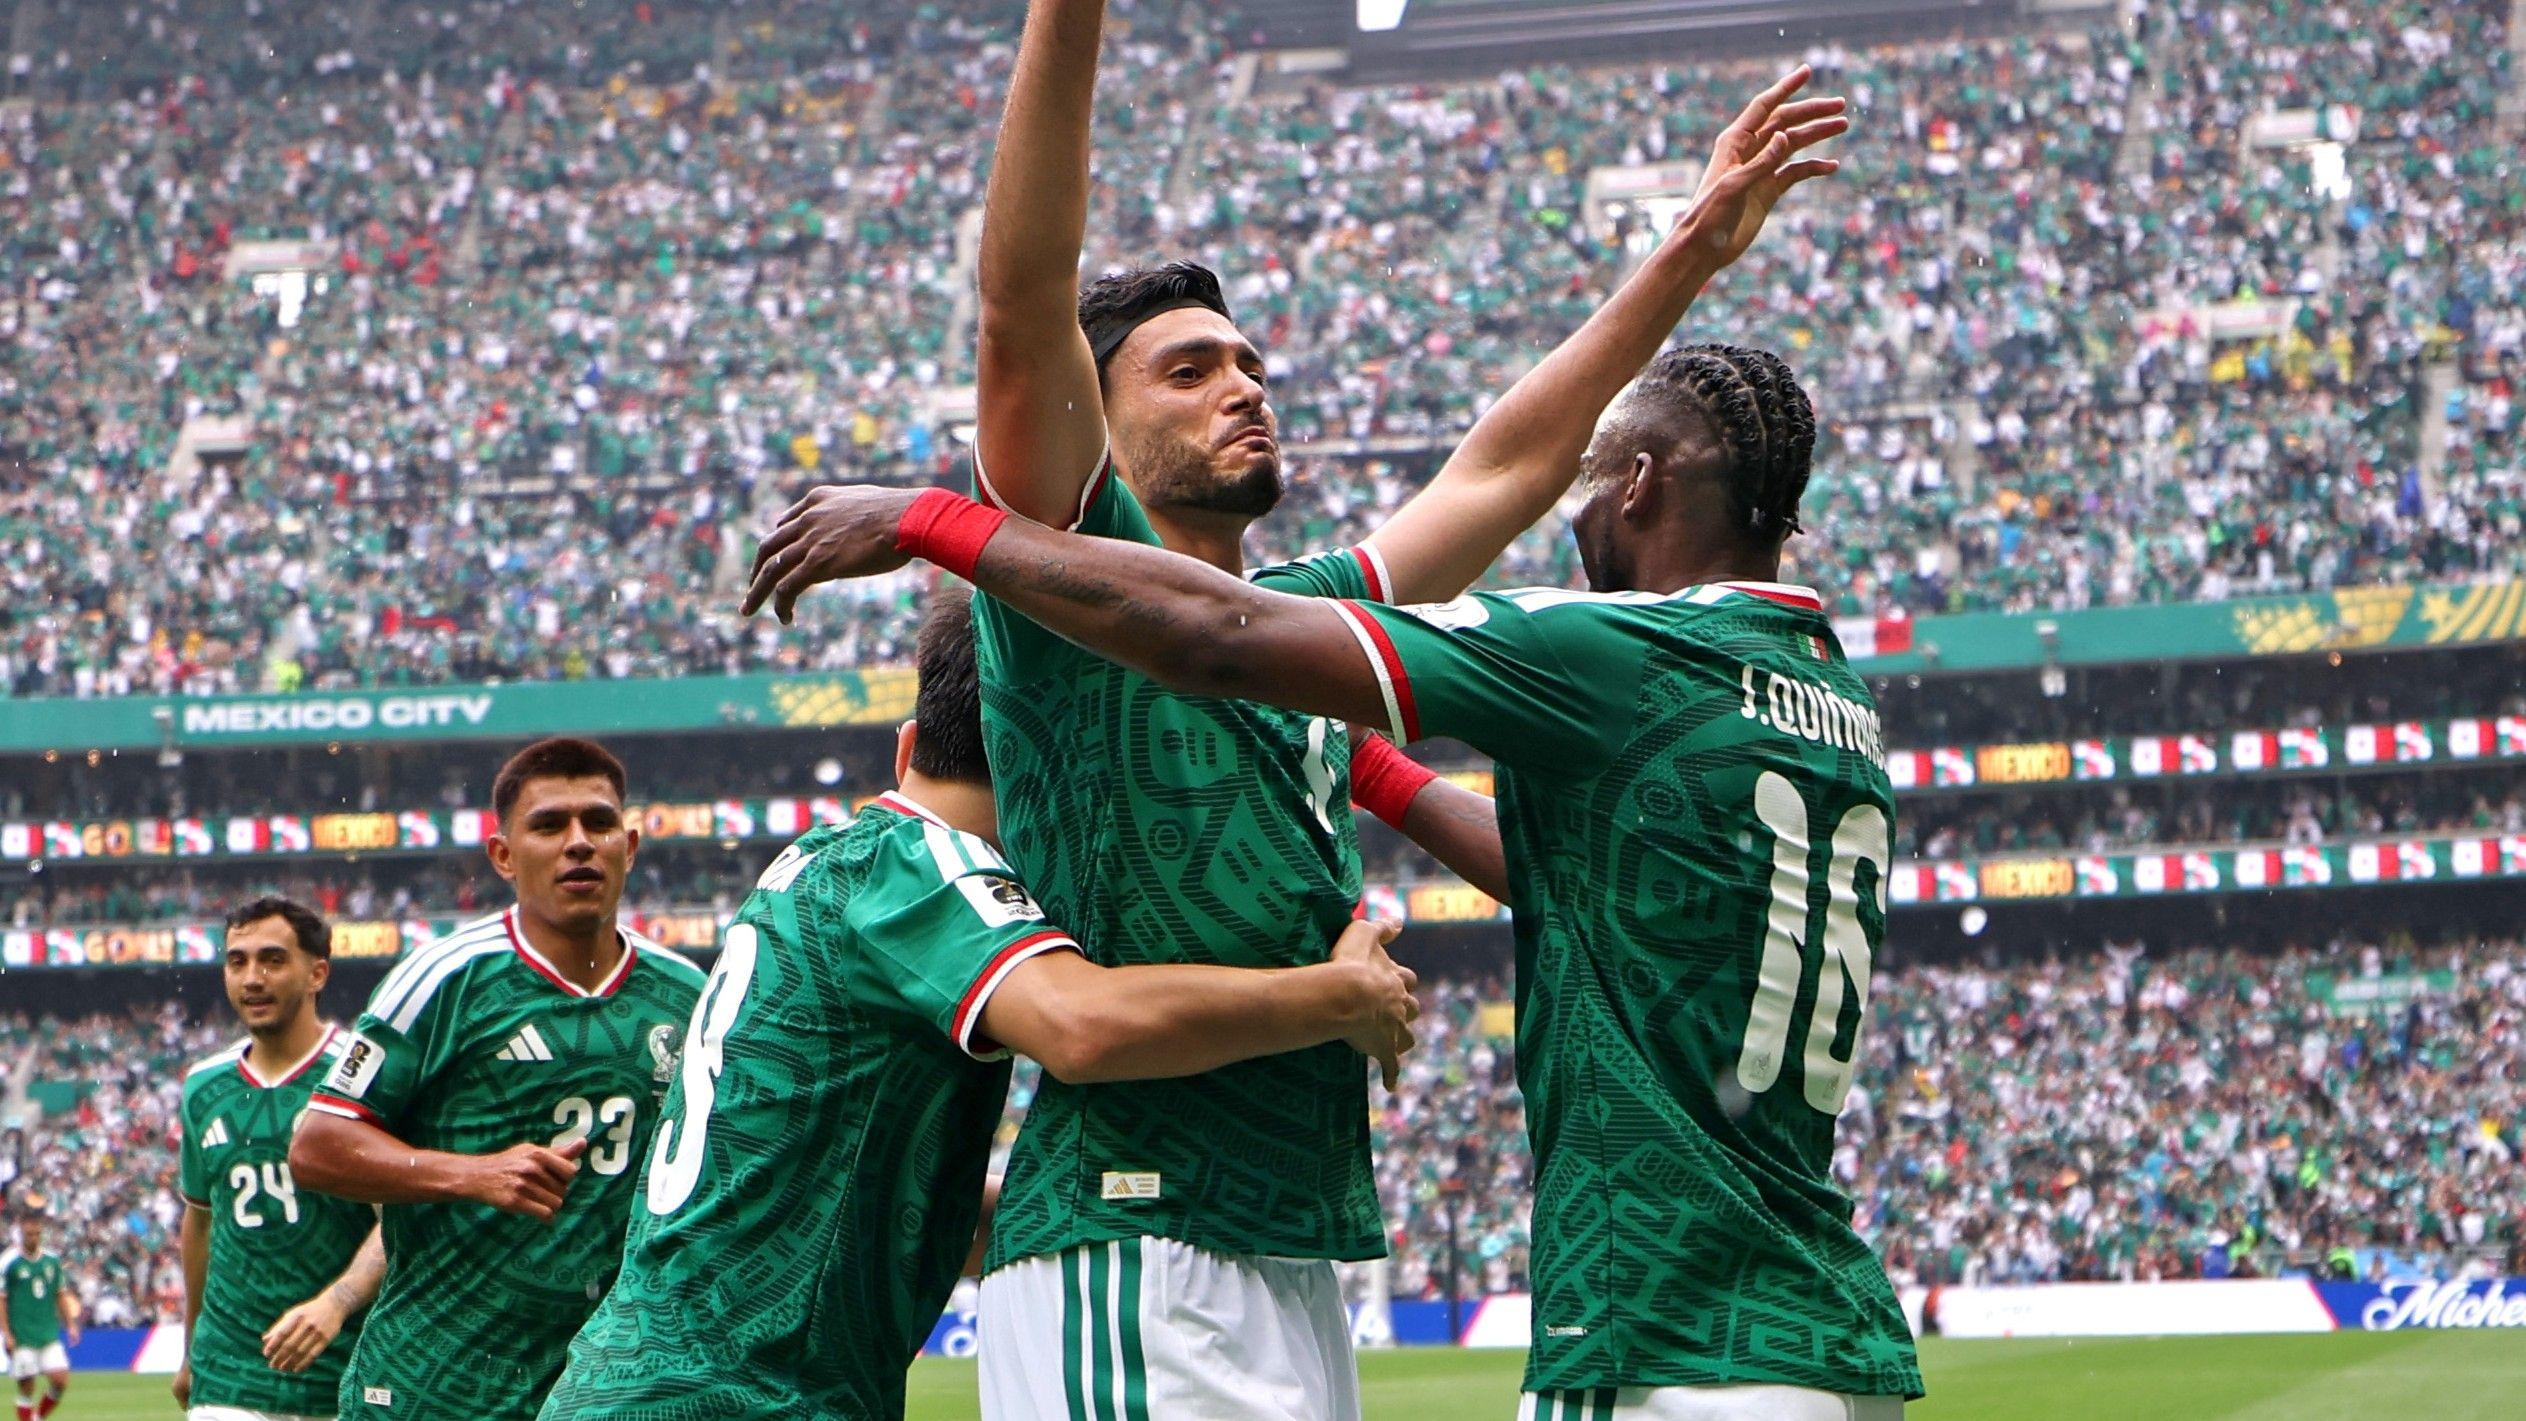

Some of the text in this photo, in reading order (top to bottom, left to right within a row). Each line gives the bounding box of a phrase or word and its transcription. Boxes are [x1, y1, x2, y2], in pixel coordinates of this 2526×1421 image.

[184, 695, 493, 733] MEXICO CITY
[1741, 664, 1885, 770] J.QUIÑONE
[1977, 741, 2071, 783] MEXICO
[312, 812, 397, 848] MEXICO
[1981, 857, 2075, 897] MEXICO
[331, 920, 398, 957] EXICO
[1737, 770, 1888, 1115] 16
[551, 1097, 635, 1175] 23
[230, 1162, 298, 1228] 24
